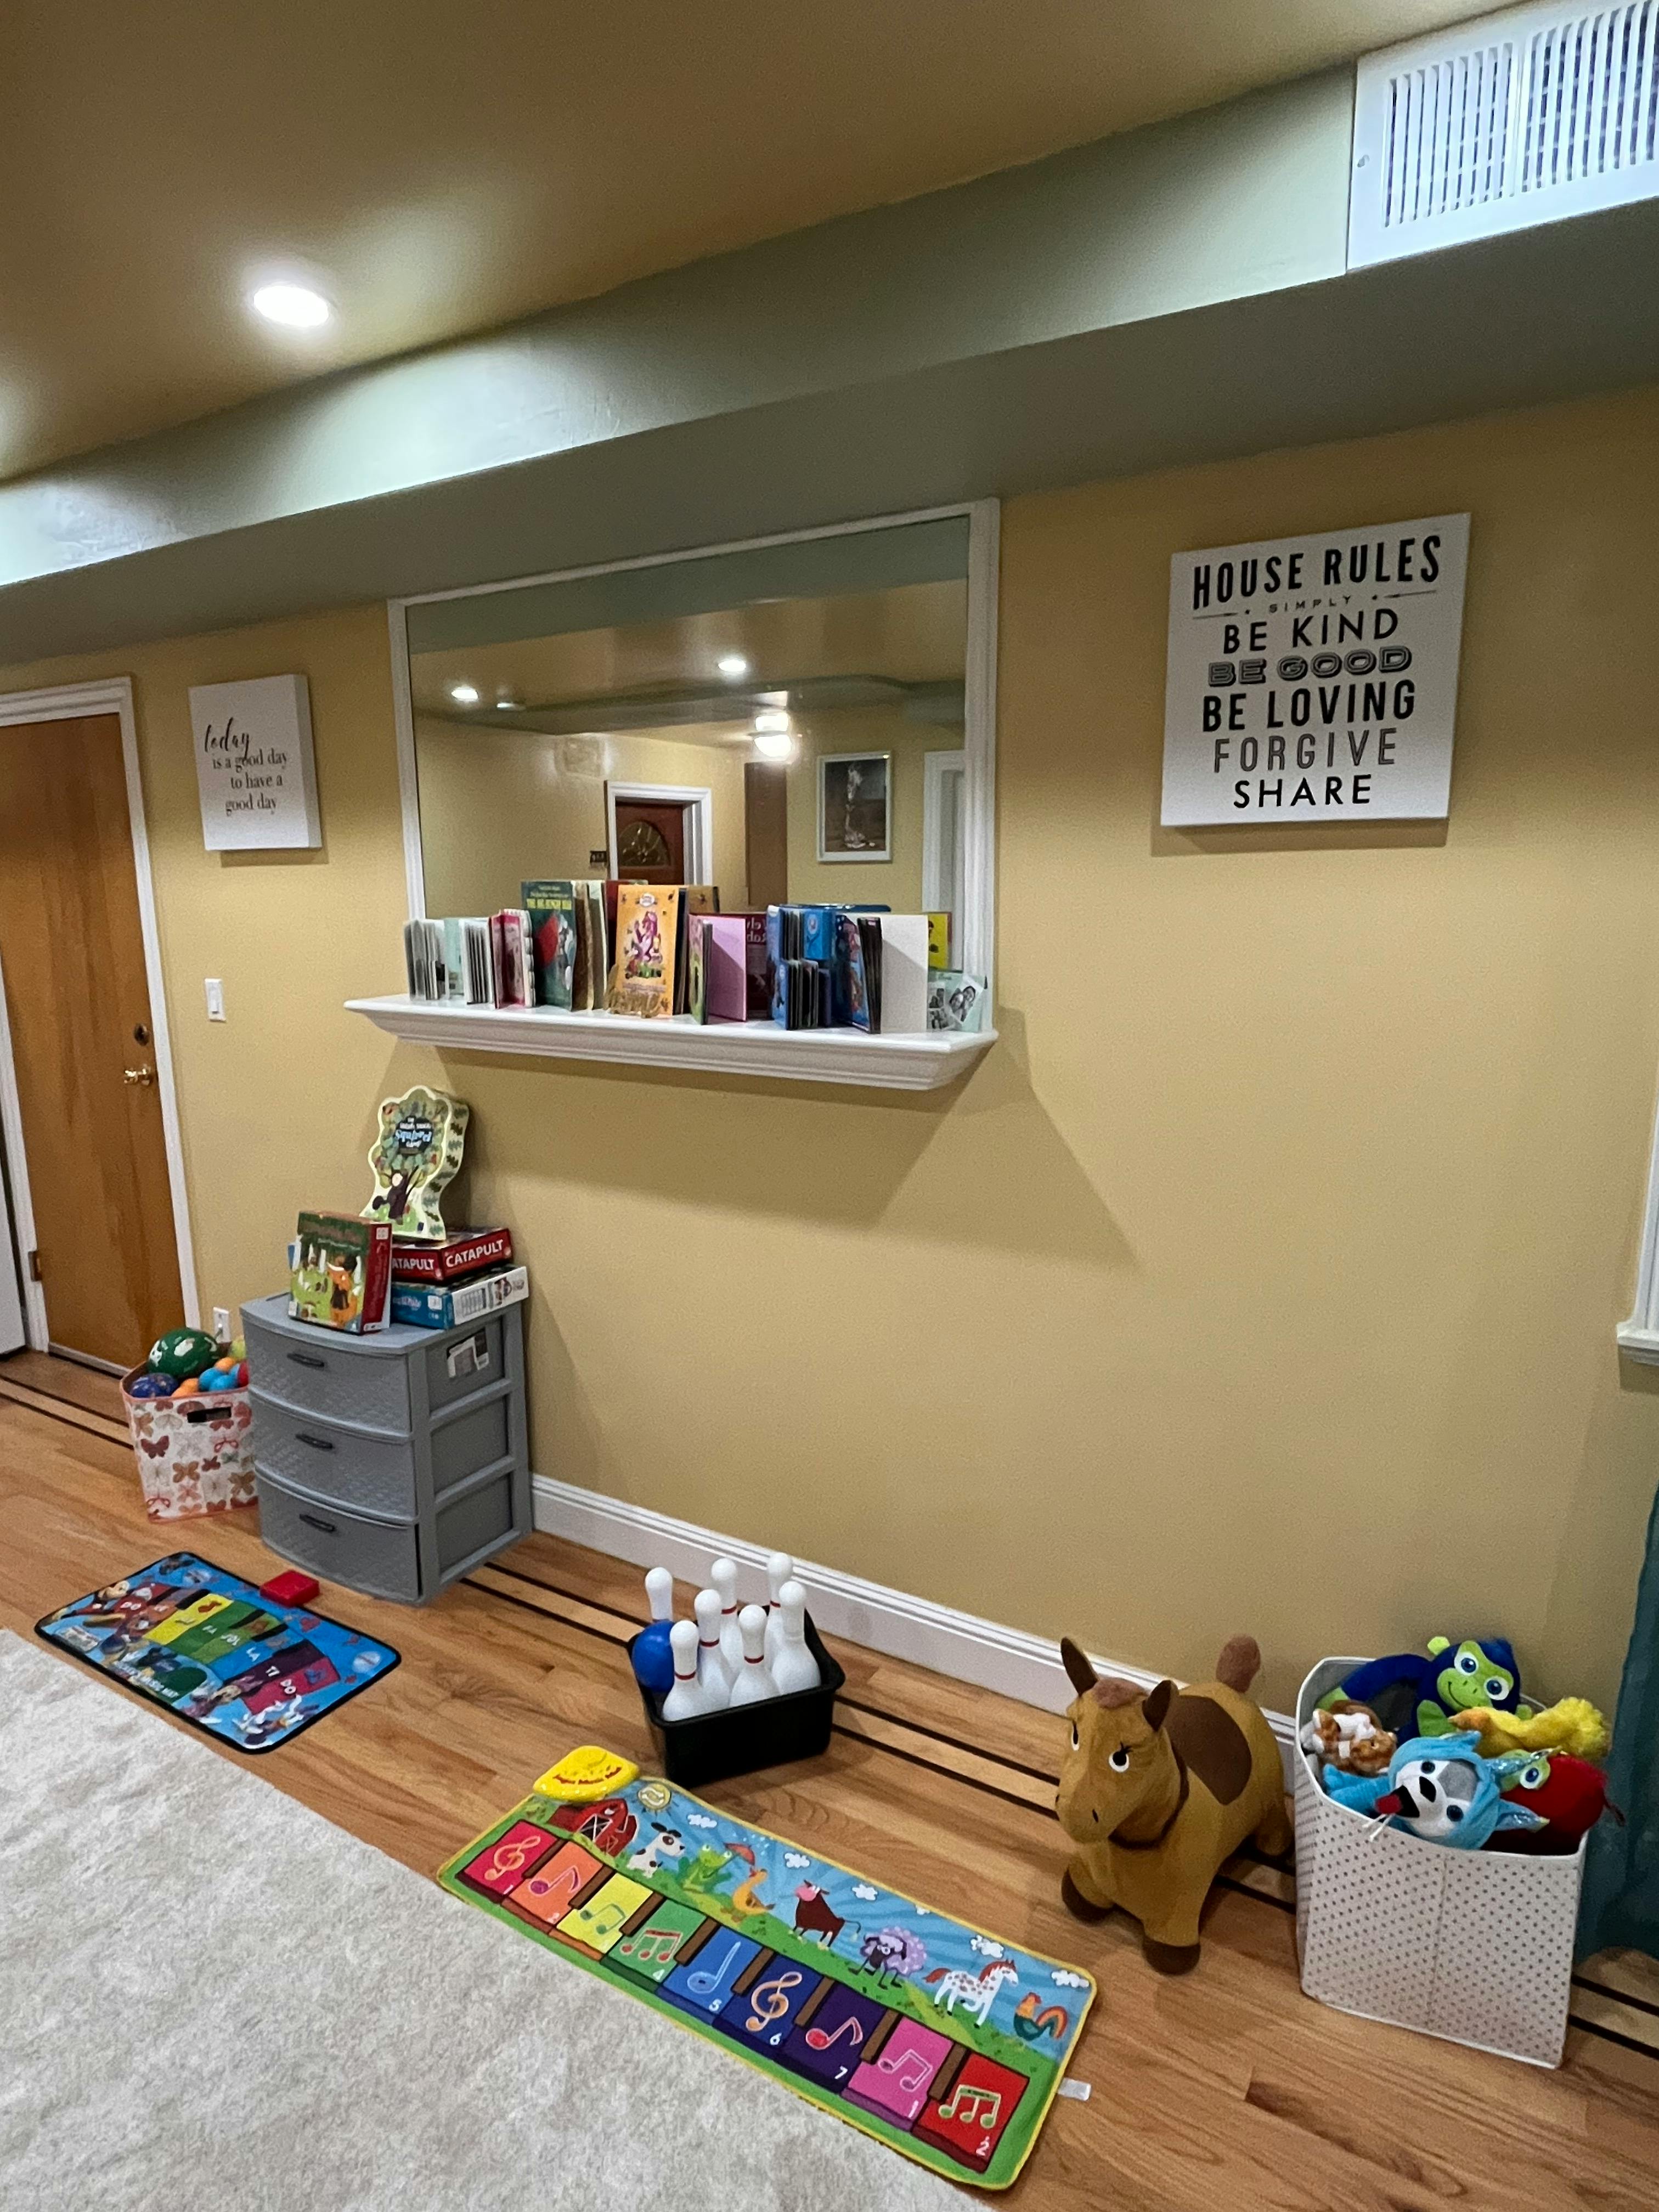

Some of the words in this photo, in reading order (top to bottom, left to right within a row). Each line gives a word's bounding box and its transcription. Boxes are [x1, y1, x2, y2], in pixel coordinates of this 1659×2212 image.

[1193, 553, 1304, 610] HOUSE
[1324, 535, 1441, 585] RULES
[1269, 595, 1352, 613] SIMPLY
[1224, 621, 1267, 653] BE
[1292, 608, 1398, 647] KIND
[1208, 659, 1267, 687] BE
[1276, 645, 1412, 682] GOOD
[1203, 693, 1246, 732] BE
[1267, 679, 1415, 728] LOVING
[213, 753, 222, 769] is
[225, 758, 232, 768] a
[235, 748, 263, 773] good
[268, 748, 287, 769] day
[1214, 728, 1397, 773] FORGIVE
[230, 777, 242, 789] to
[245, 772, 273, 788] have
[276, 775, 283, 786] a
[1233, 774, 1372, 809] SHARE
[225, 793, 253, 816] good
[257, 793, 276, 814] day
[391, 1258, 435, 1271] ATAPULT
[446, 1239, 504, 1268] CATAPULT
[120, 1601, 142, 1611] DO
[266, 1666, 280, 1677] TI
[280, 1679, 296, 1694] DO
[653, 1968, 665, 1980] 4
[709, 1999, 723, 2011] 5
[770, 2032, 782, 2045] 6
[834, 2066, 848, 2079] 7
[908, 2100, 919, 2119] 1
